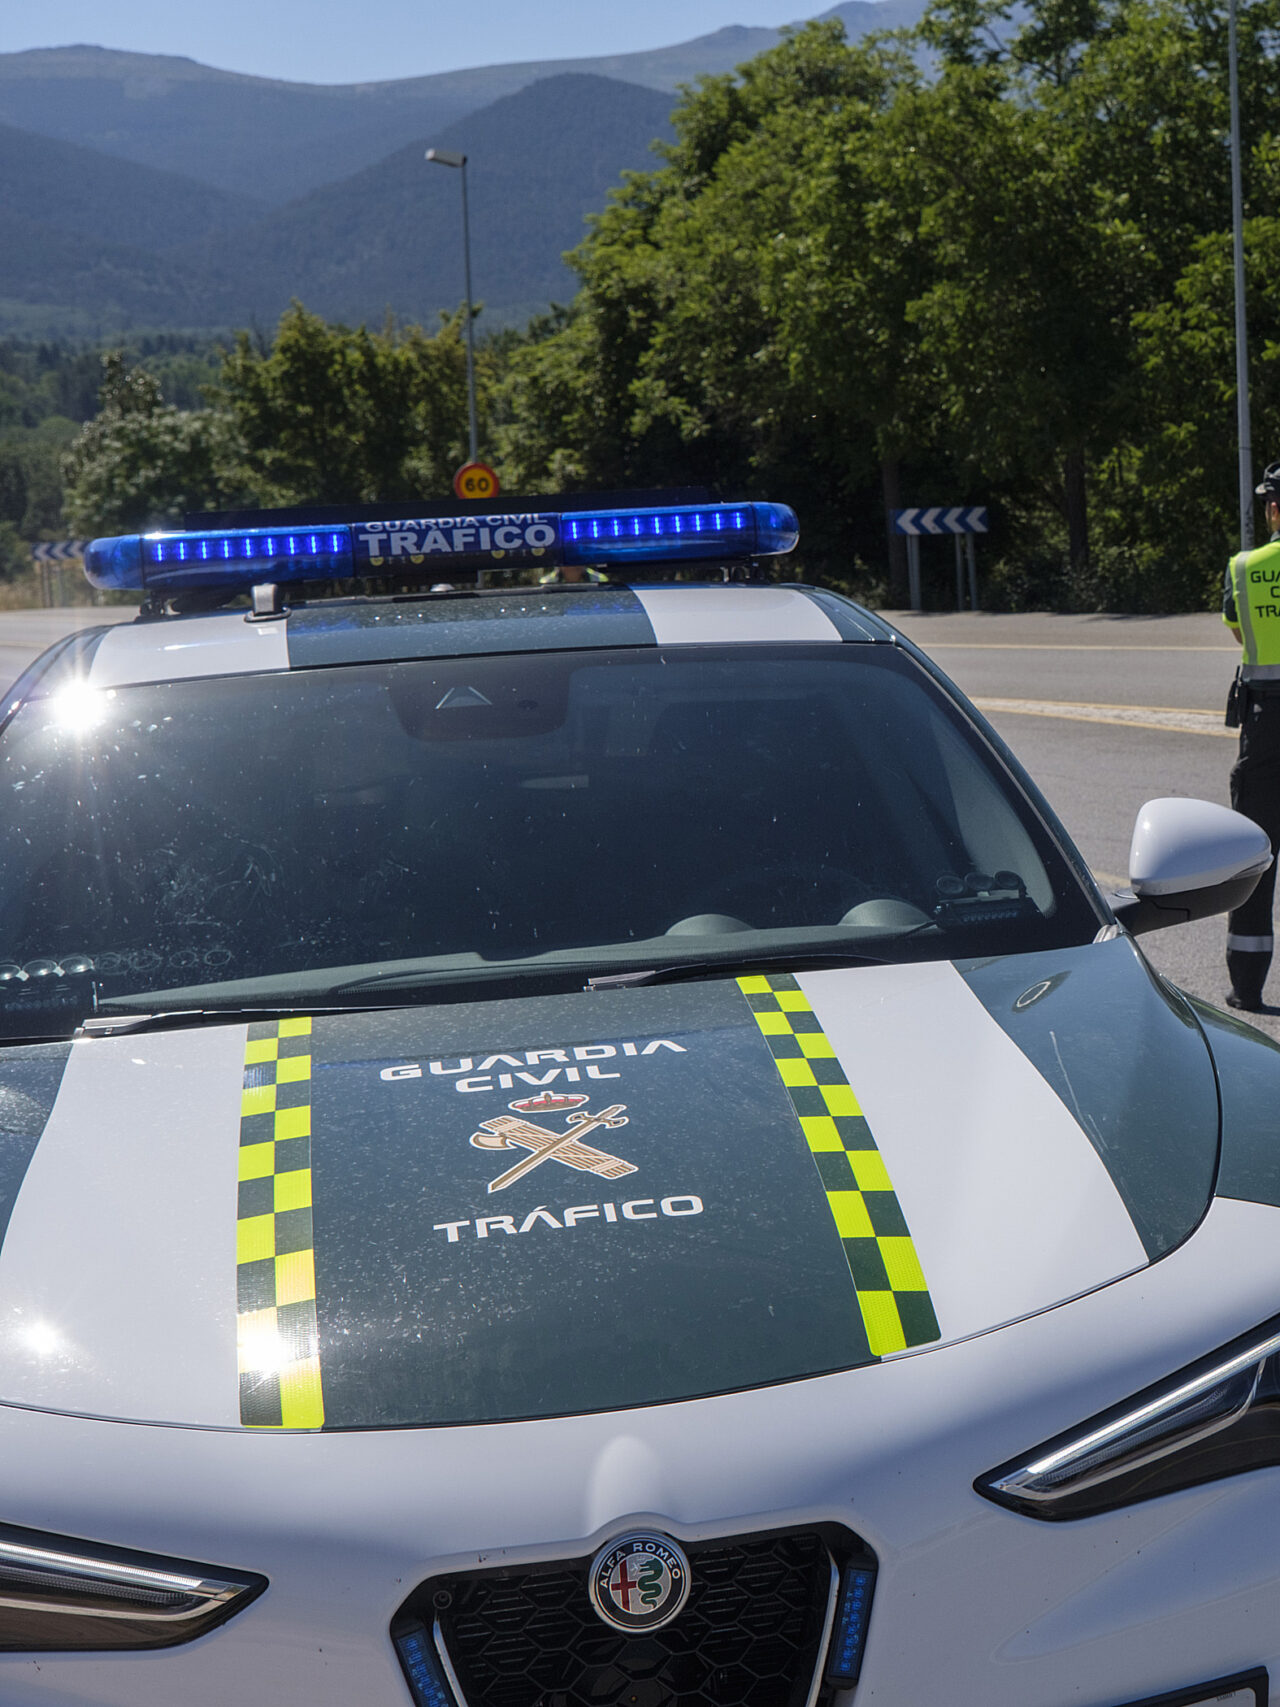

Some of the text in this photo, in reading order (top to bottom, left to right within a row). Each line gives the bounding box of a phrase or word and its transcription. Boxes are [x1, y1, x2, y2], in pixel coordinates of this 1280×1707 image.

[466, 478, 490, 492] 60
[365, 513, 548, 533] GUARDIA CIVIL
[358, 524, 556, 557] TRÁFICO
[380, 1039, 688, 1081] GUARDIA
[455, 1065, 621, 1093] CIVIL
[433, 1195, 704, 1243] TRÁFICO
[600, 1542, 681, 1588] ALFA ROMEO
